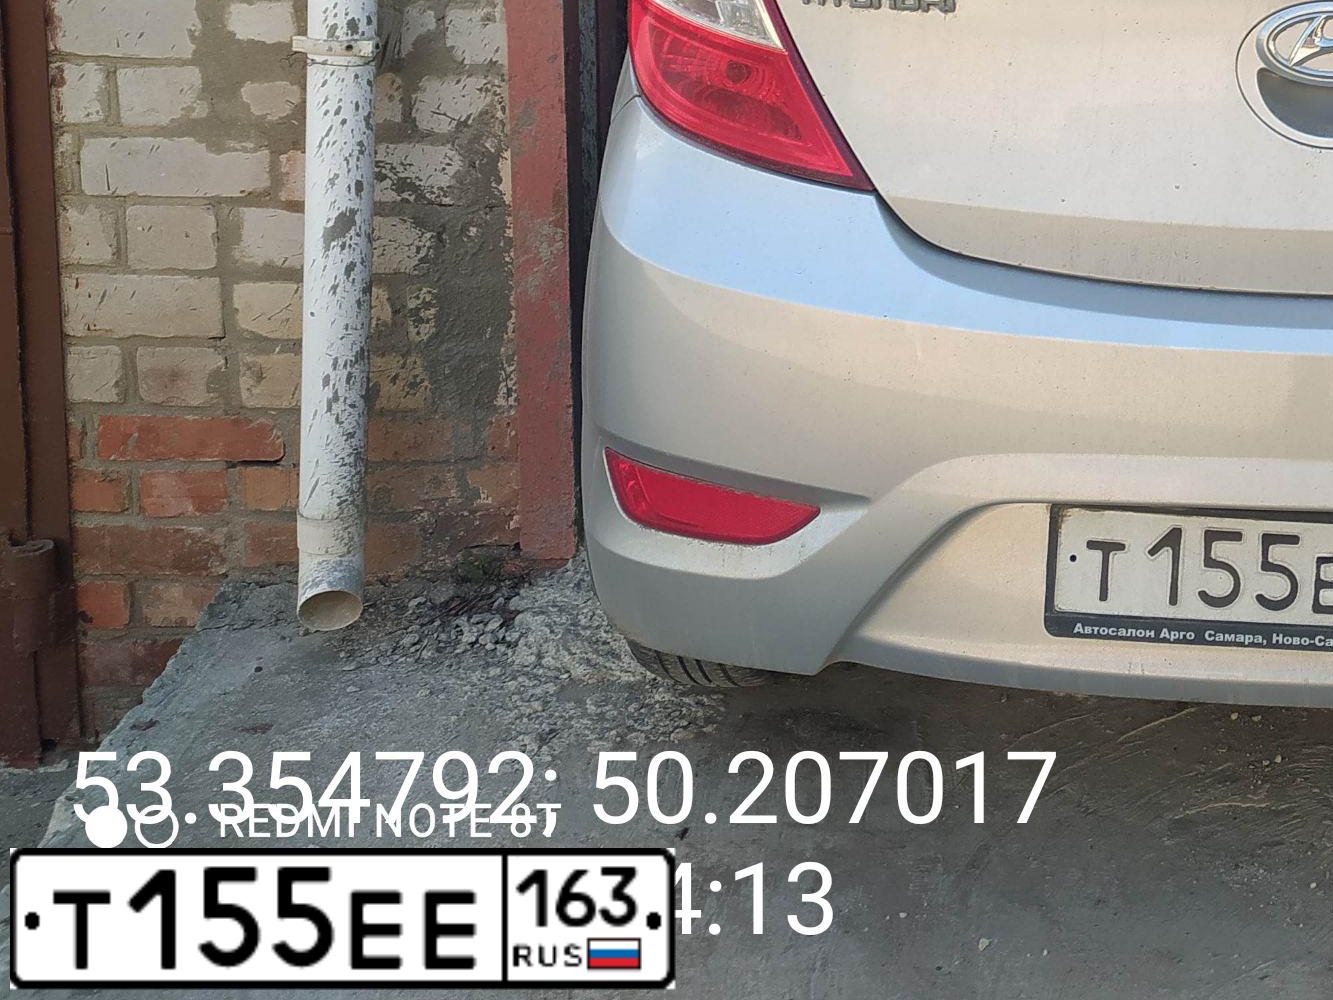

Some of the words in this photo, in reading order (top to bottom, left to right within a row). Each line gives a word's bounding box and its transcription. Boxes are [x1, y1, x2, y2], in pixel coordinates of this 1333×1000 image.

[1072, 622, 1155, 639] Автосалон
[1159, 627, 1196, 641] Арго
[1204, 630, 1267, 646] Самара,
